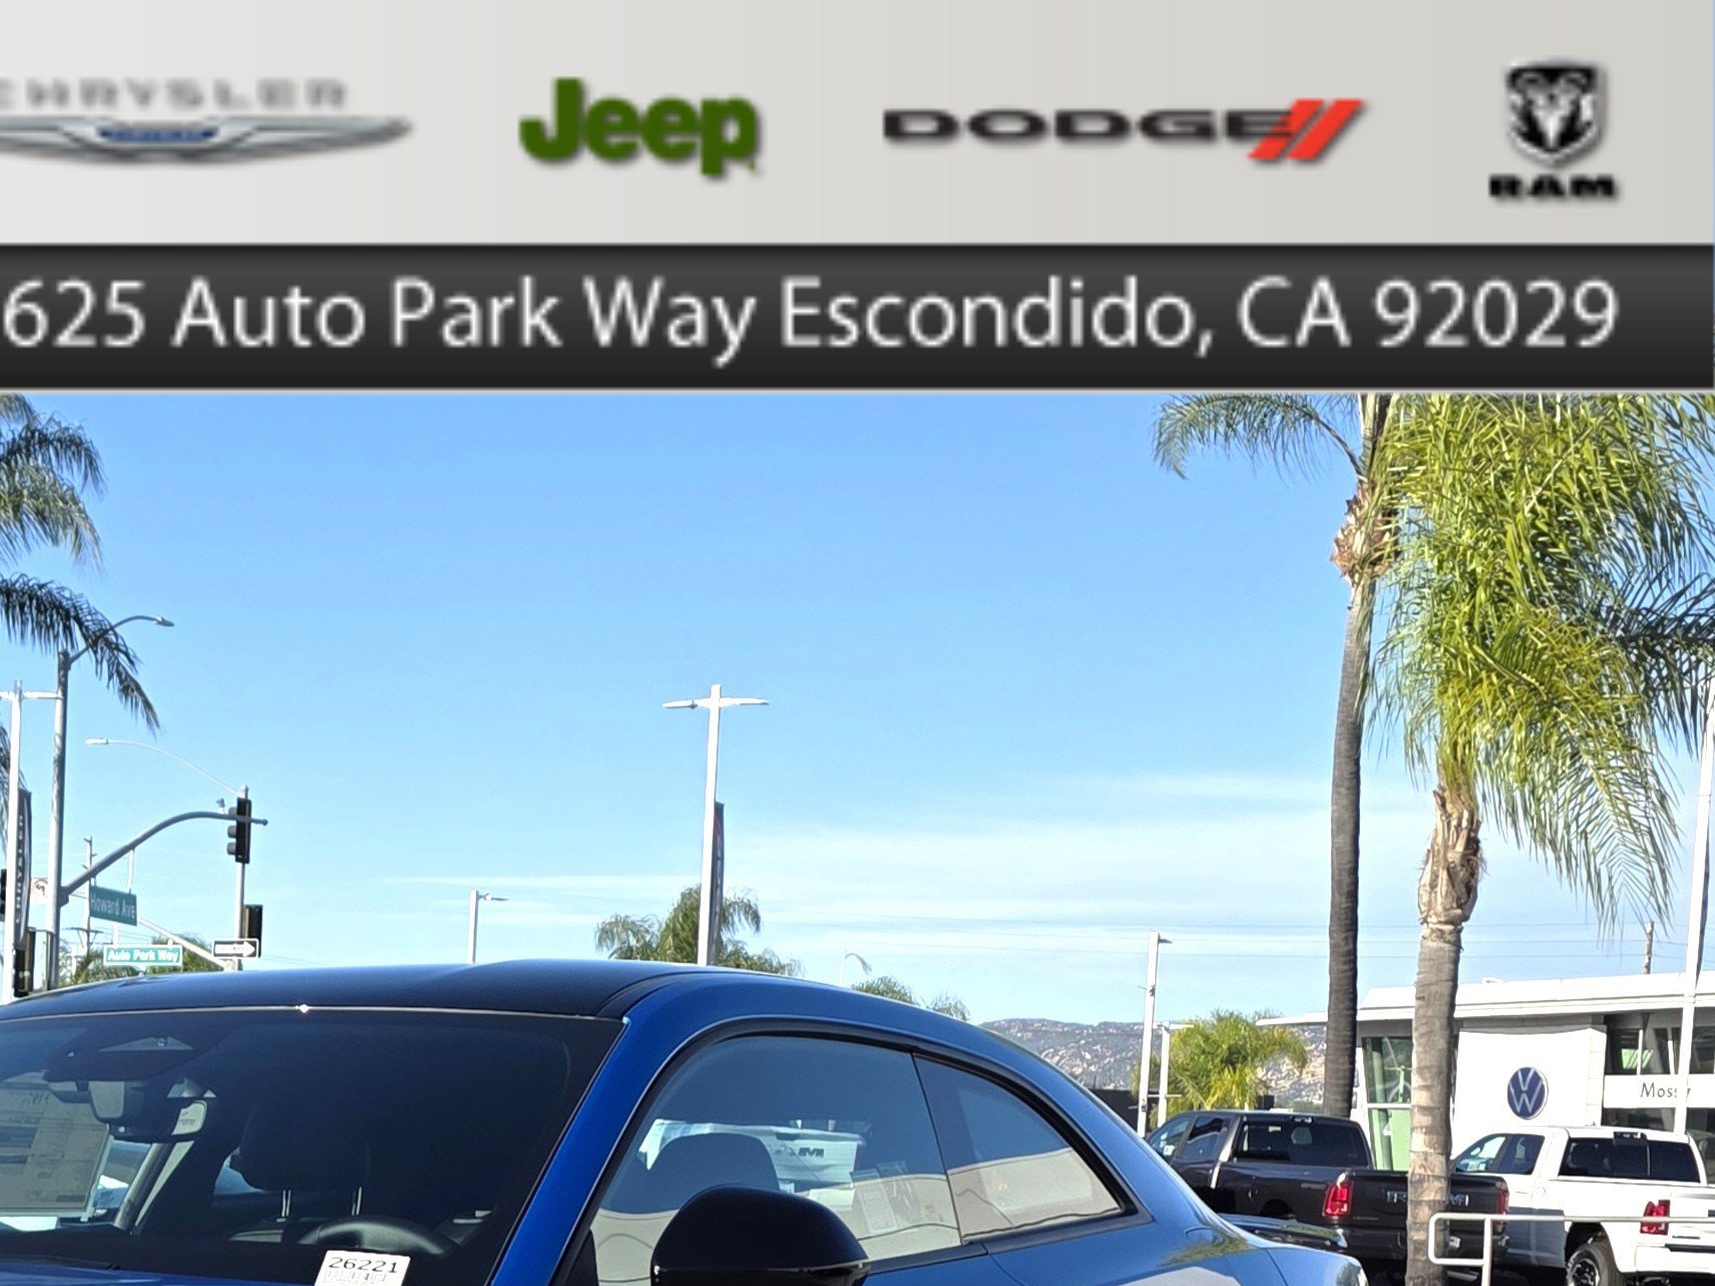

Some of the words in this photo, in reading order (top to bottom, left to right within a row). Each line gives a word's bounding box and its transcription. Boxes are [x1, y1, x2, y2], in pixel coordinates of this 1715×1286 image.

[90, 891, 120, 916] Howard
[122, 899, 135, 919] Ave
[107, 949, 131, 961] Auto
[132, 949, 156, 961] Park
[157, 949, 179, 963] Way
[328, 1257, 398, 1273] 26221
